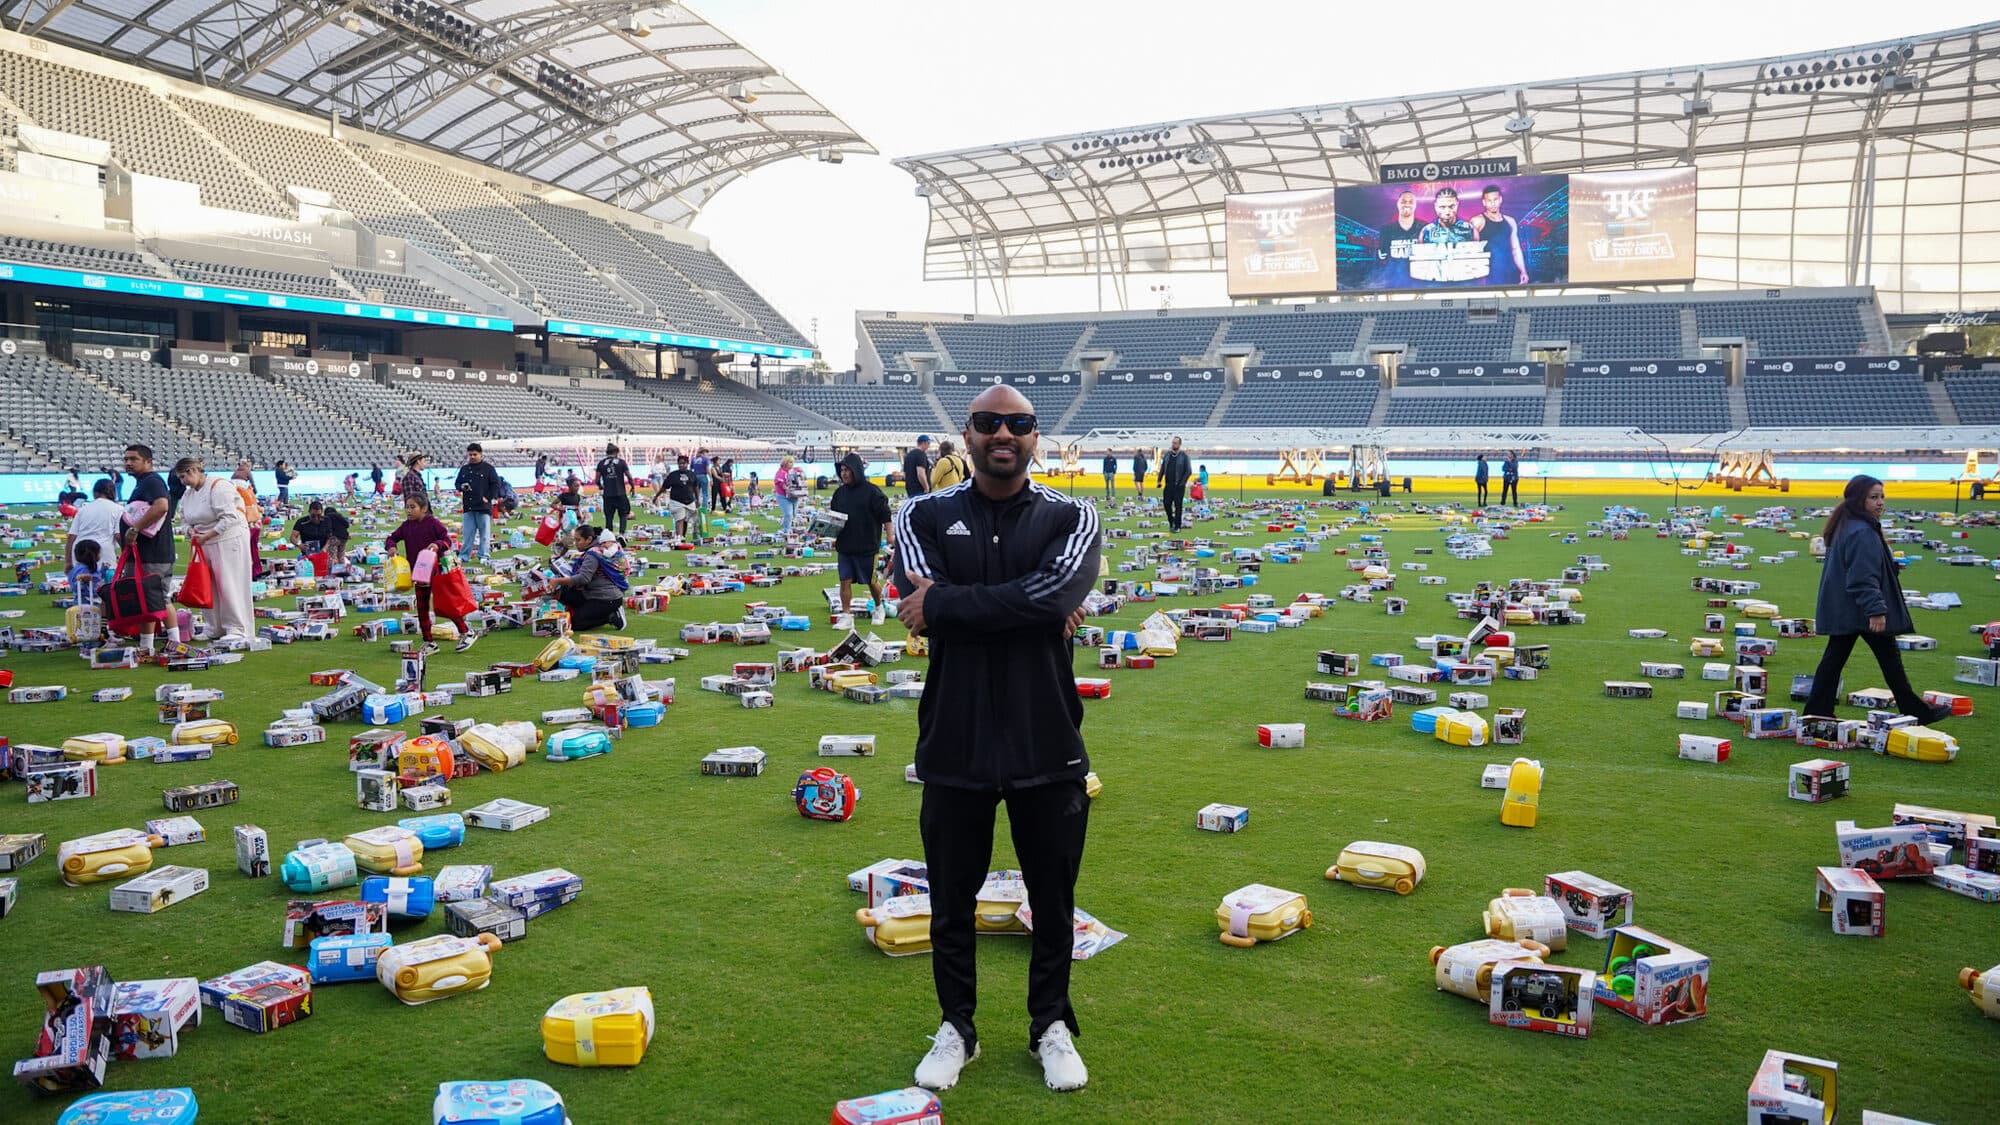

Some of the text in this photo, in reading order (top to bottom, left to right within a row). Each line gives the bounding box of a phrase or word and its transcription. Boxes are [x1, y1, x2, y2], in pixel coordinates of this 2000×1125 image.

[1387, 162, 1511, 180] BMO STADIUM
[284, 361, 304, 371] BMO
[328, 364, 347, 373] BMO
[945, 528, 971, 536] adidas
[70, 1040, 78, 1064] FORD
